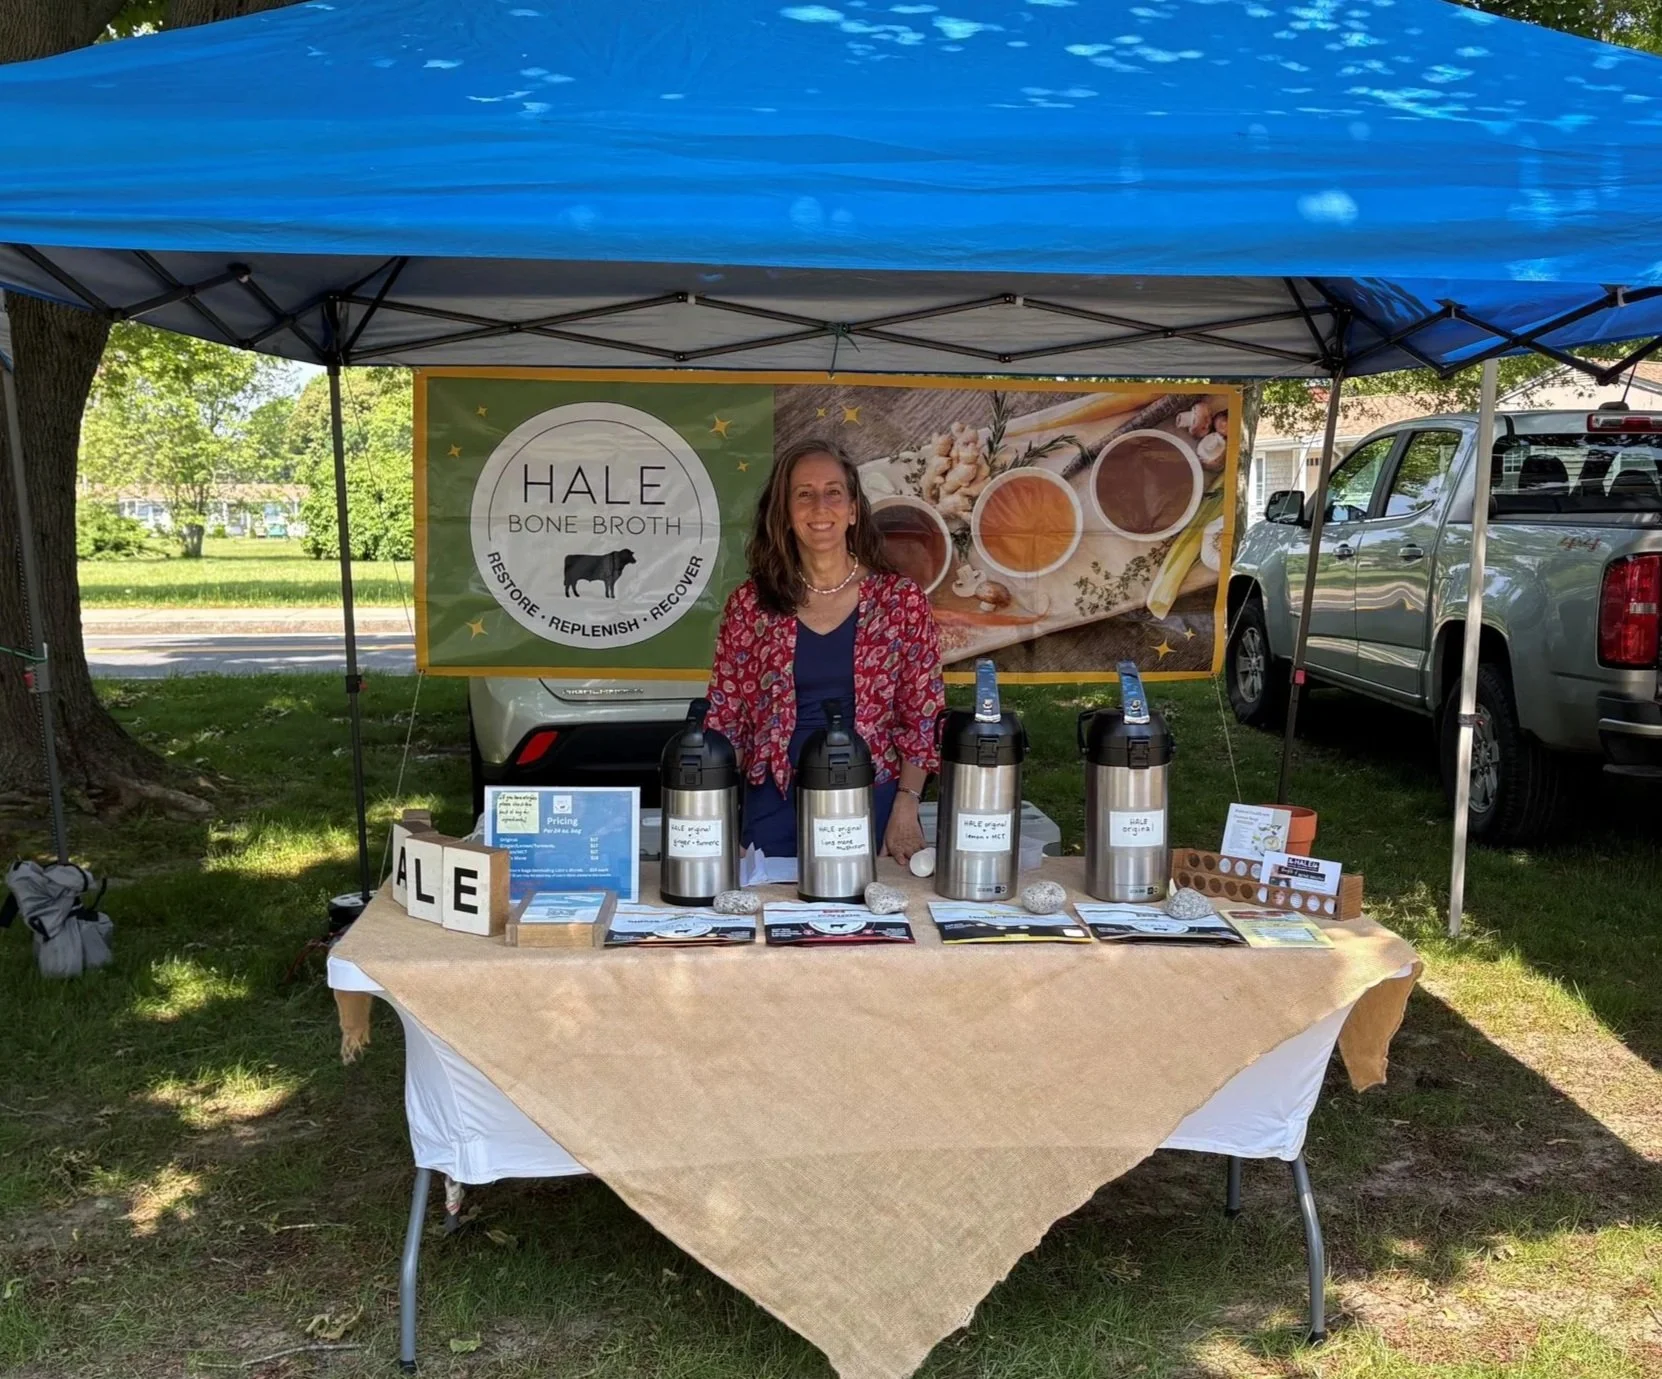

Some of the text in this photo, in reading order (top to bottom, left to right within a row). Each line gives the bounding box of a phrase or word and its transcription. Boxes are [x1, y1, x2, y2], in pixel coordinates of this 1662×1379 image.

[523, 463, 666, 506] HALE
[508, 514, 681, 536] BONE BROTH
[487, 551, 704, 637] RESTORE REPLENISH RECOVER
[546, 817, 579, 827] Pricing
